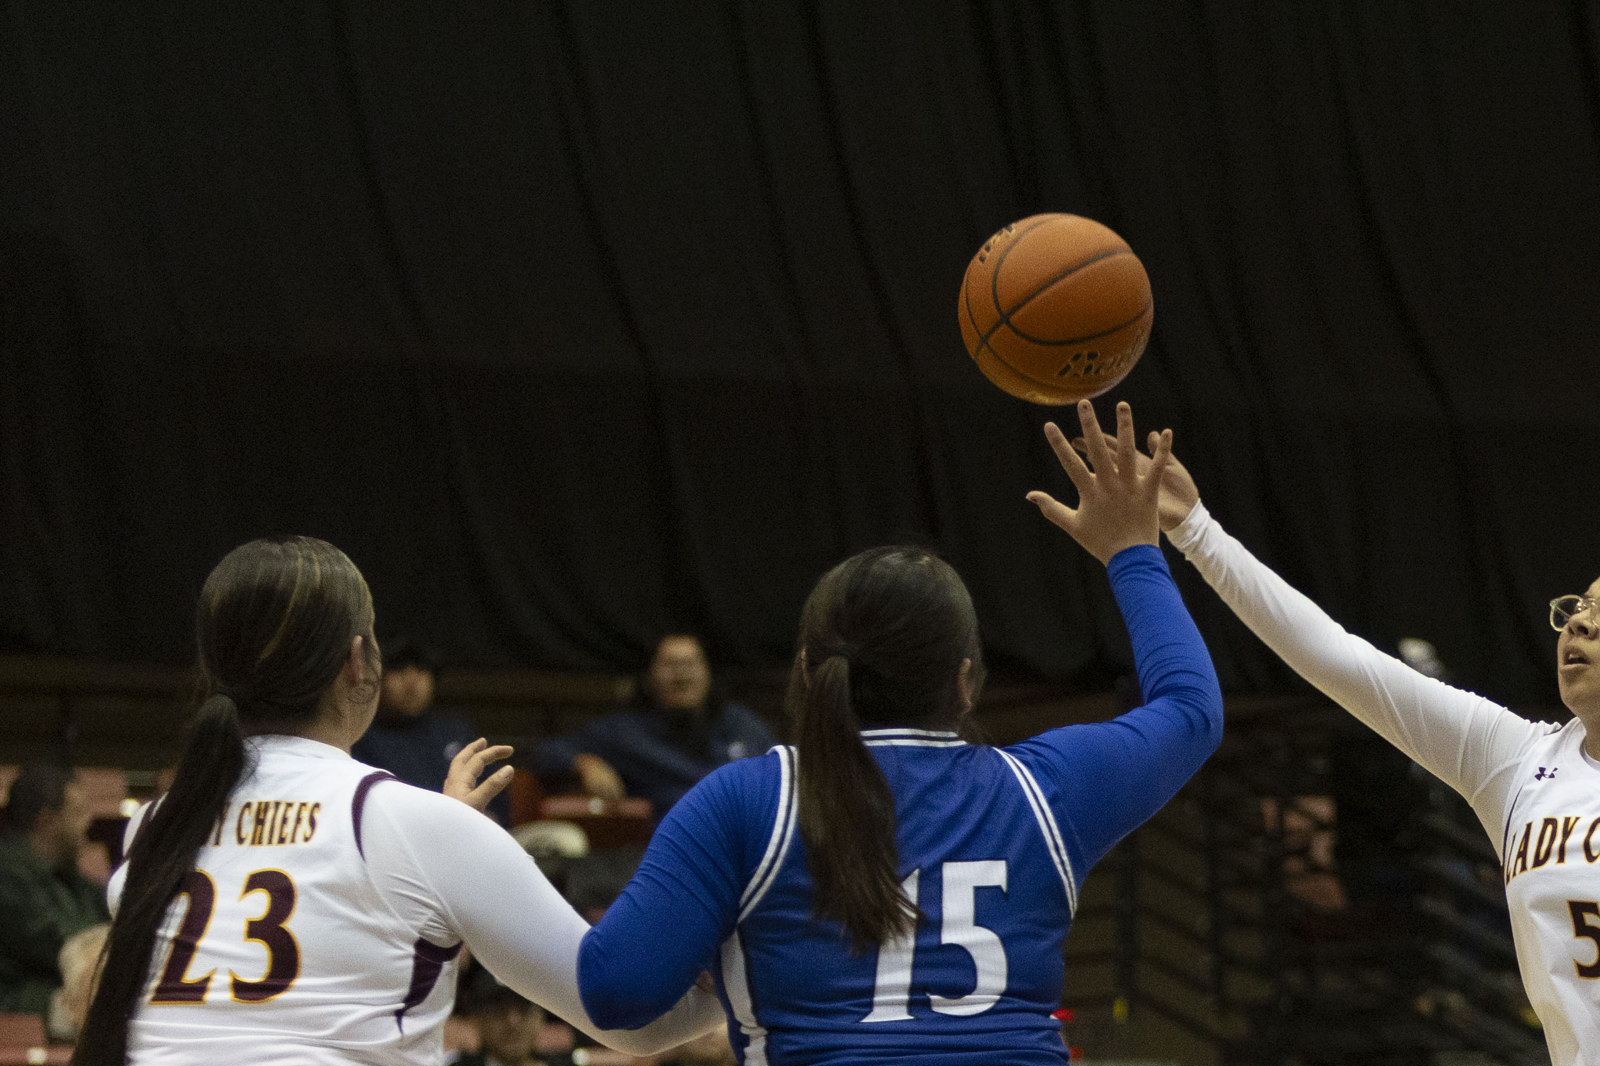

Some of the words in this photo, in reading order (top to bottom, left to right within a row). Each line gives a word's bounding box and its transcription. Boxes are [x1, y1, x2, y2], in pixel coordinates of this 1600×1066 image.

[236, 800, 321, 847] CHIEFS
[1504, 816, 1581, 888] LADY
[148, 867, 303, 1005] 23
[860, 860, 1009, 1023] 15
